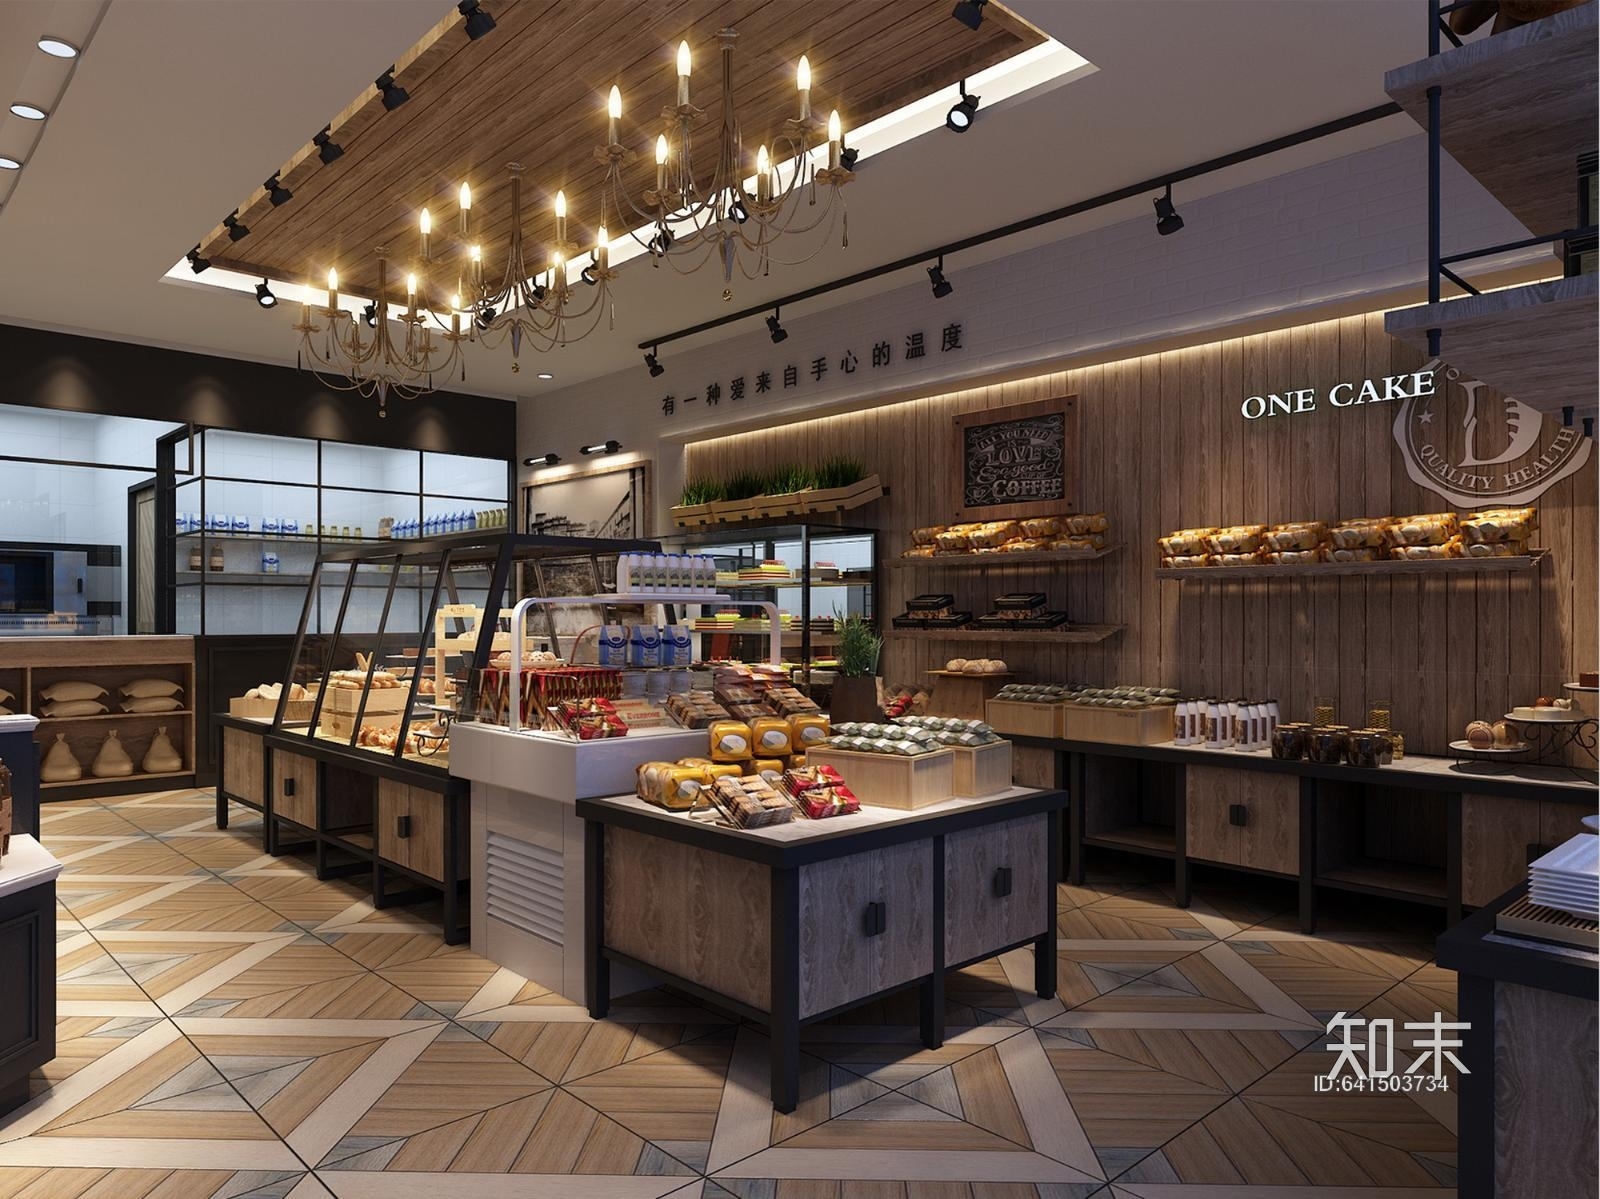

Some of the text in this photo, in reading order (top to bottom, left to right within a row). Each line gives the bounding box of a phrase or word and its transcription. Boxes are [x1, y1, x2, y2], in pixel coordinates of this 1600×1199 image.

[662, 322, 963, 417] 有一种爱来自手心的温度
[1240, 370, 1436, 420] ONE CAKE
[985, 445, 1042, 466] LOVE
[1420, 427, 1577, 489] QUALITY HEALTH
[992, 478, 1062, 497] COFFEE
